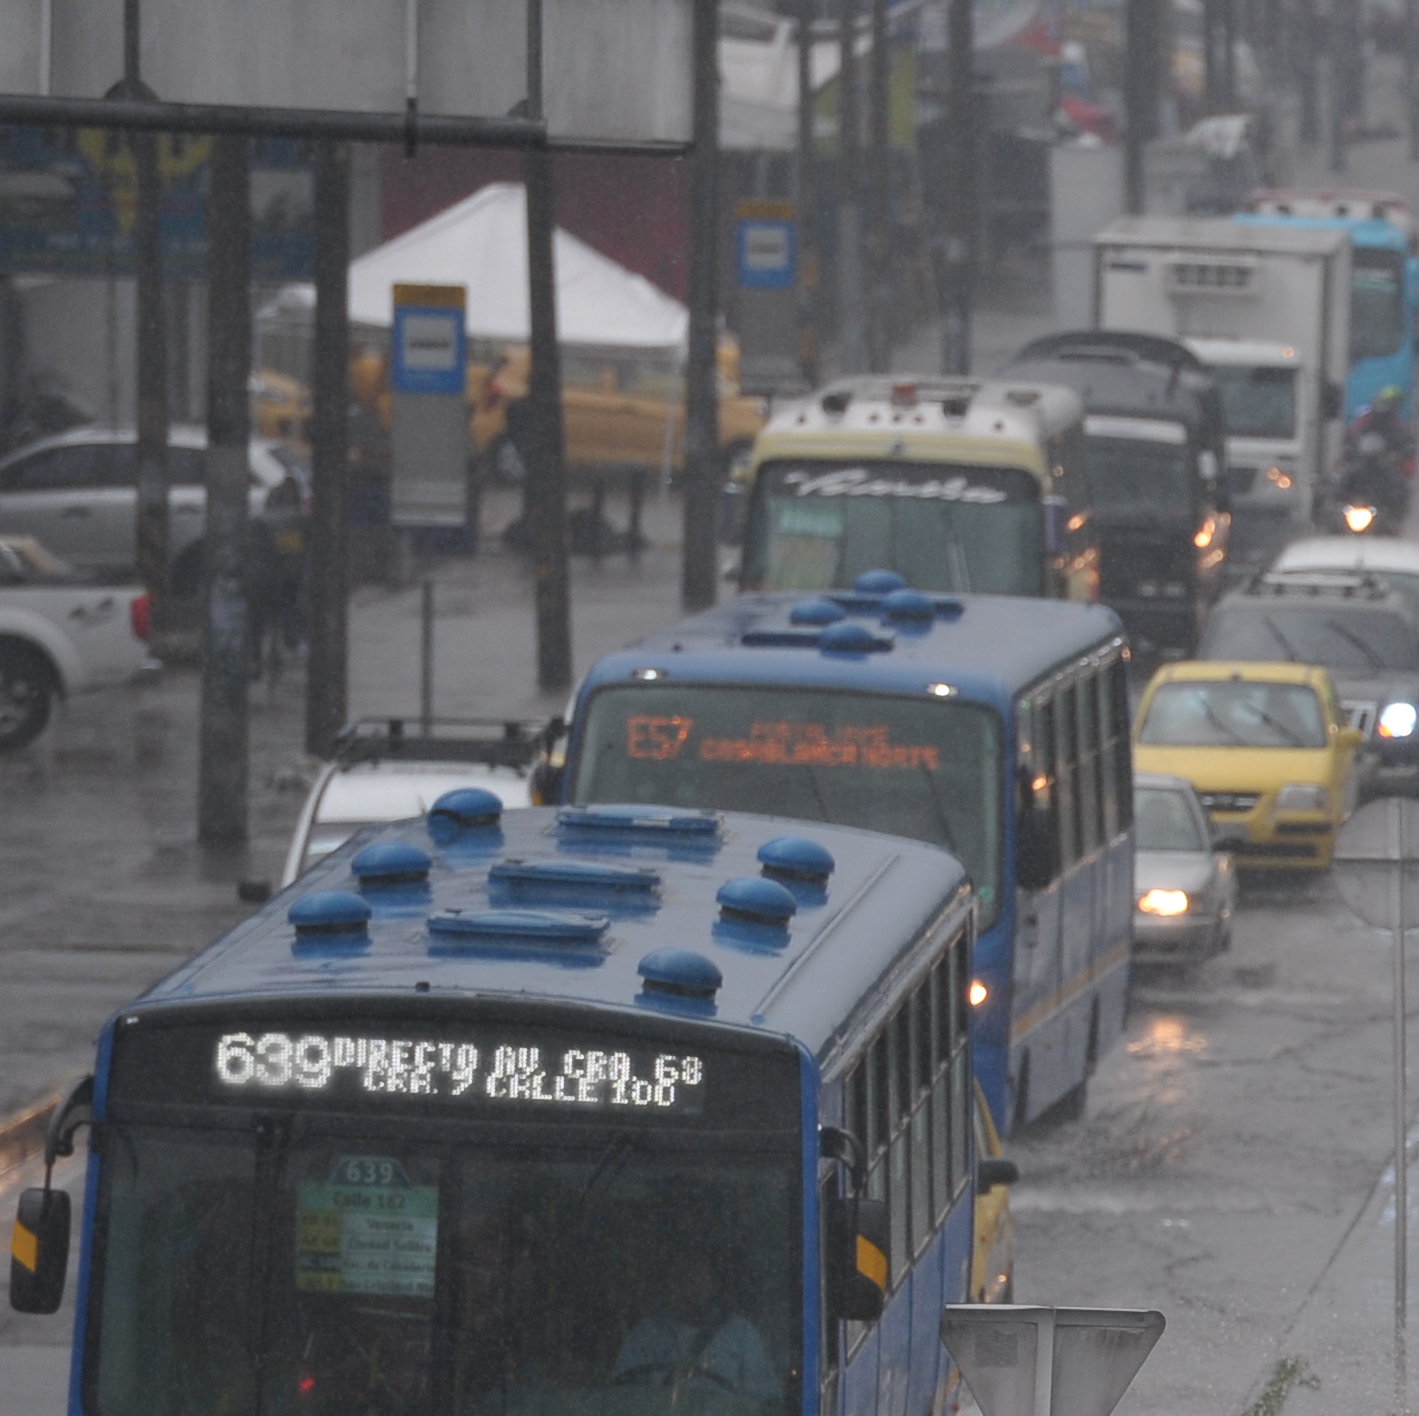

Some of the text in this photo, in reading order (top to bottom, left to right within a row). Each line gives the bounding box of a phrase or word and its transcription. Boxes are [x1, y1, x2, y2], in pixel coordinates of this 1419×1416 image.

[627, 715, 694, 759] E57
[217, 1032, 332, 1089] 639
[334, 1036, 478, 1072] DIRECTO
[487, 1072, 599, 1103] CALLE
[346, 1162, 394, 1185] 639
[332, 1191, 372, 1208] Calle
